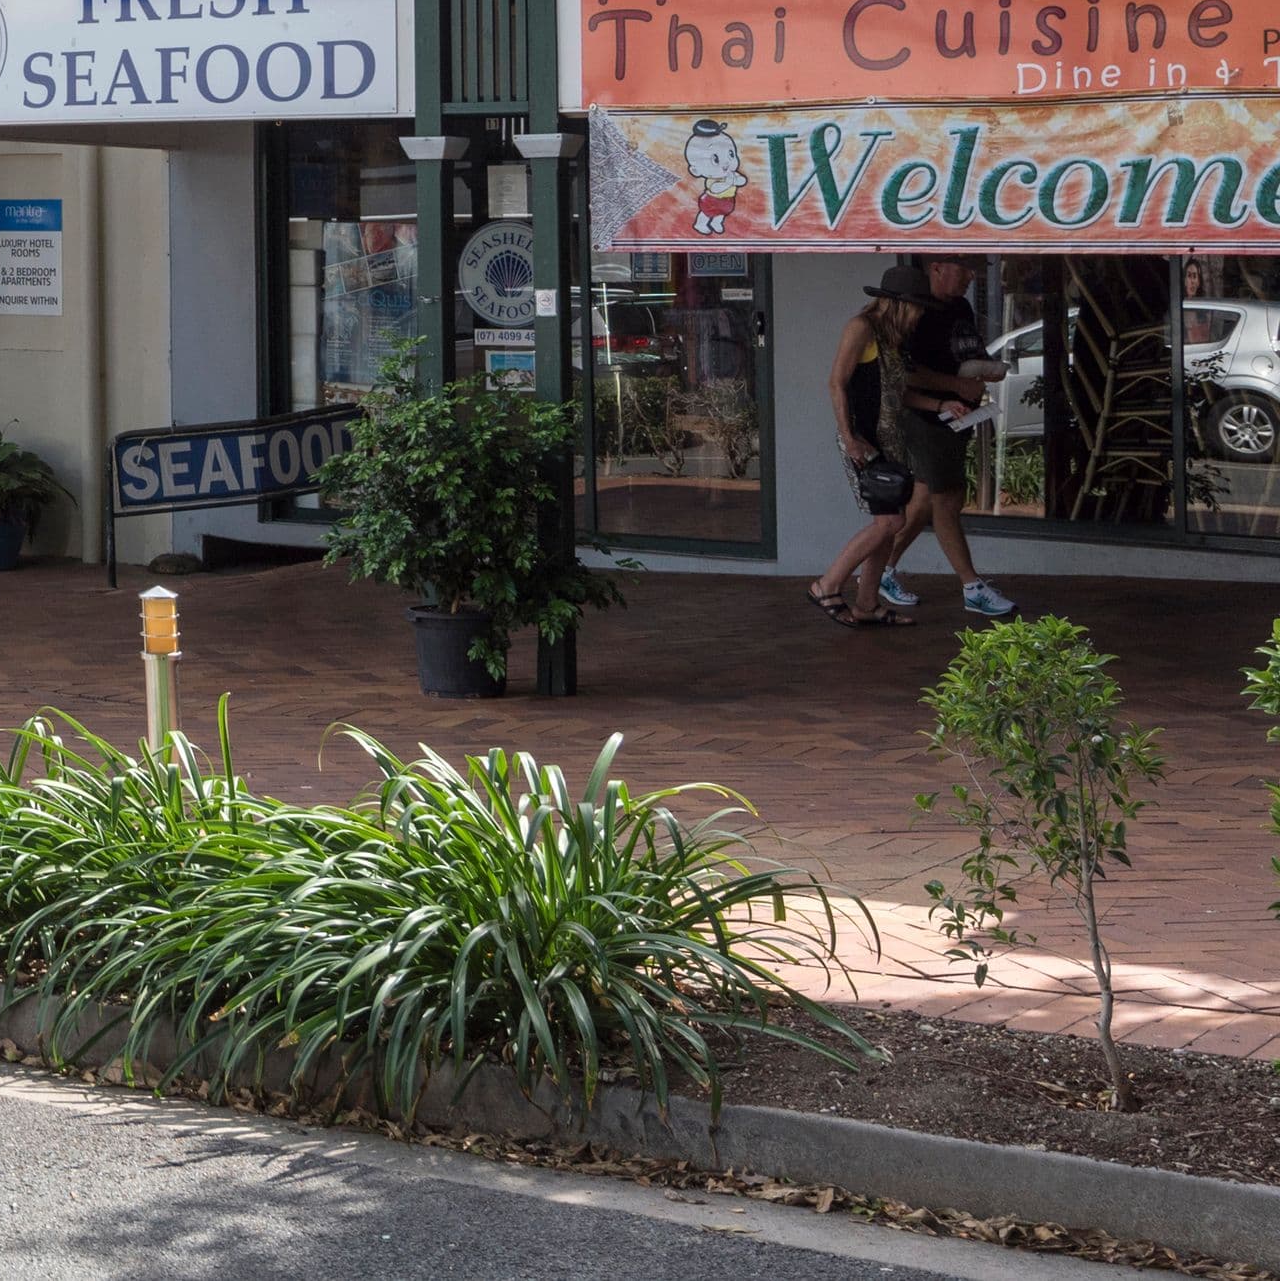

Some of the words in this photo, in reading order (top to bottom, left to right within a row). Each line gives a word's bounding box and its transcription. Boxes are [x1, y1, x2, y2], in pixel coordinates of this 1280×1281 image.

[588, 7, 787, 81] Thai
[23, 39, 376, 109] SEAFOOD
[1017, 60, 1121, 95] Dine
[1148, 57, 1187, 87] in
[5, 204, 48, 218] mantra
[29, 239, 55, 248] HOTEL
[465, 232, 533, 269] SEASHEL
[11, 249, 41, 258] ROOMS
[692, 253, 743, 270] OPEN
[9, 267, 15, 276] 2
[16, 267, 57, 277] BEDROOM
[1, 277, 51, 287] APARTMENTS
[31, 296, 58, 306] WITHIN
[471, 285, 535, 319] SEAFOO
[476, 331, 496, 343] (07)
[498, 331, 522, 341] 4099
